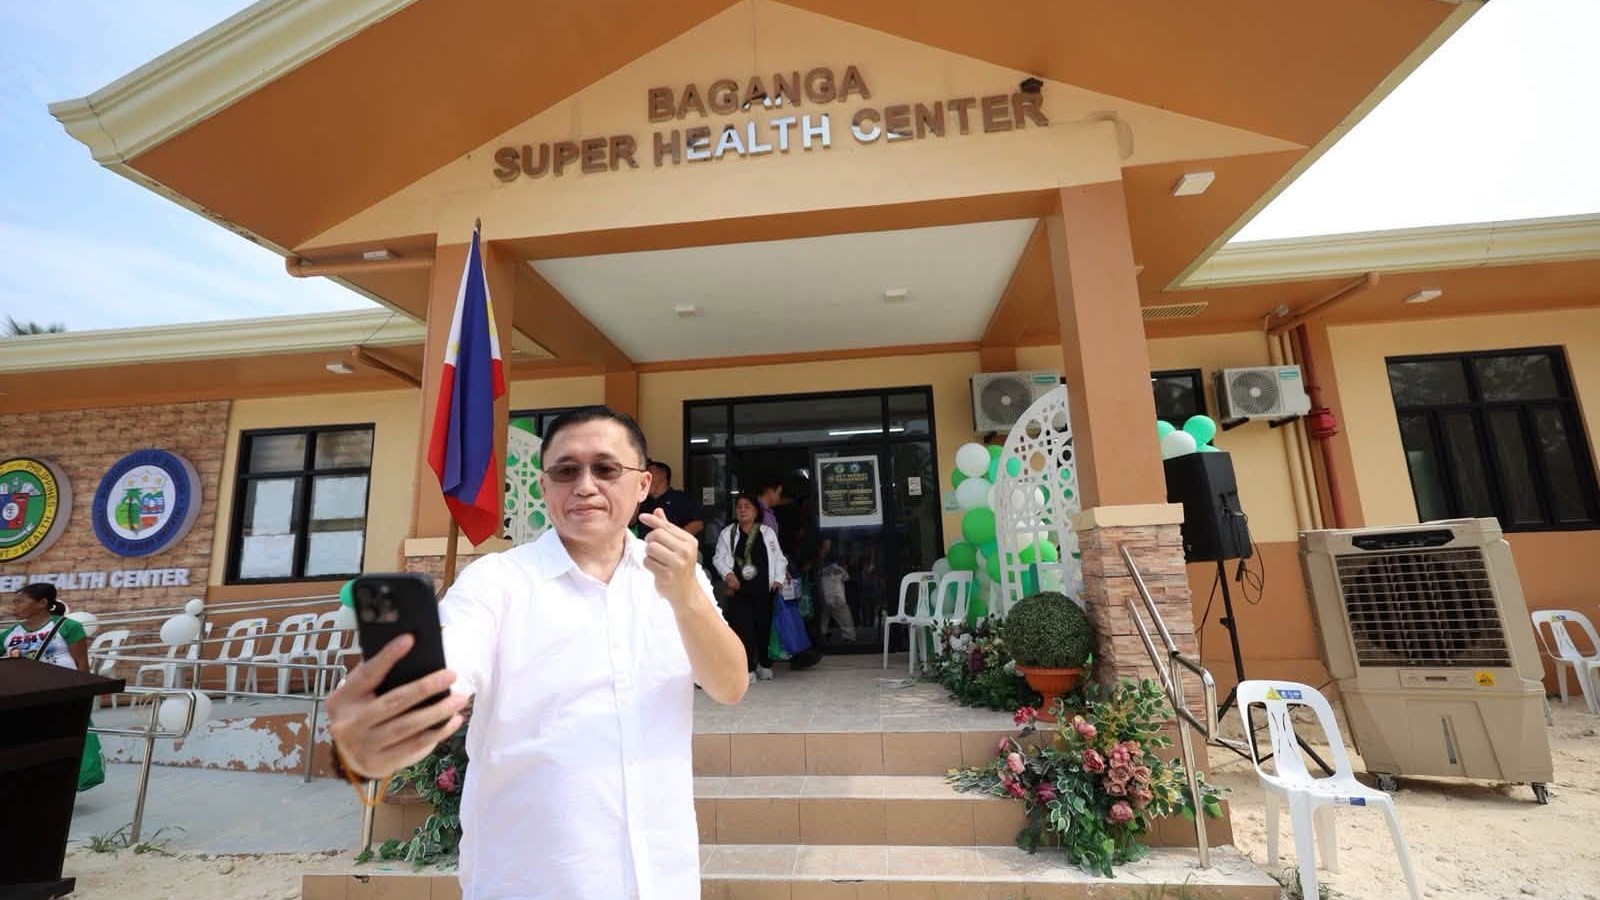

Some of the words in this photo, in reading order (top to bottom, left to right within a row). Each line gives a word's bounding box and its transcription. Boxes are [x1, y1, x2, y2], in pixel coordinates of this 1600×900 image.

[647, 65, 871, 122] BAGANGA
[493, 134, 640, 183] SUPER
[653, 113, 832, 167] HEALTH
[851, 92, 1049, 145] CENTER
[110, 568, 191, 588] CENTER
